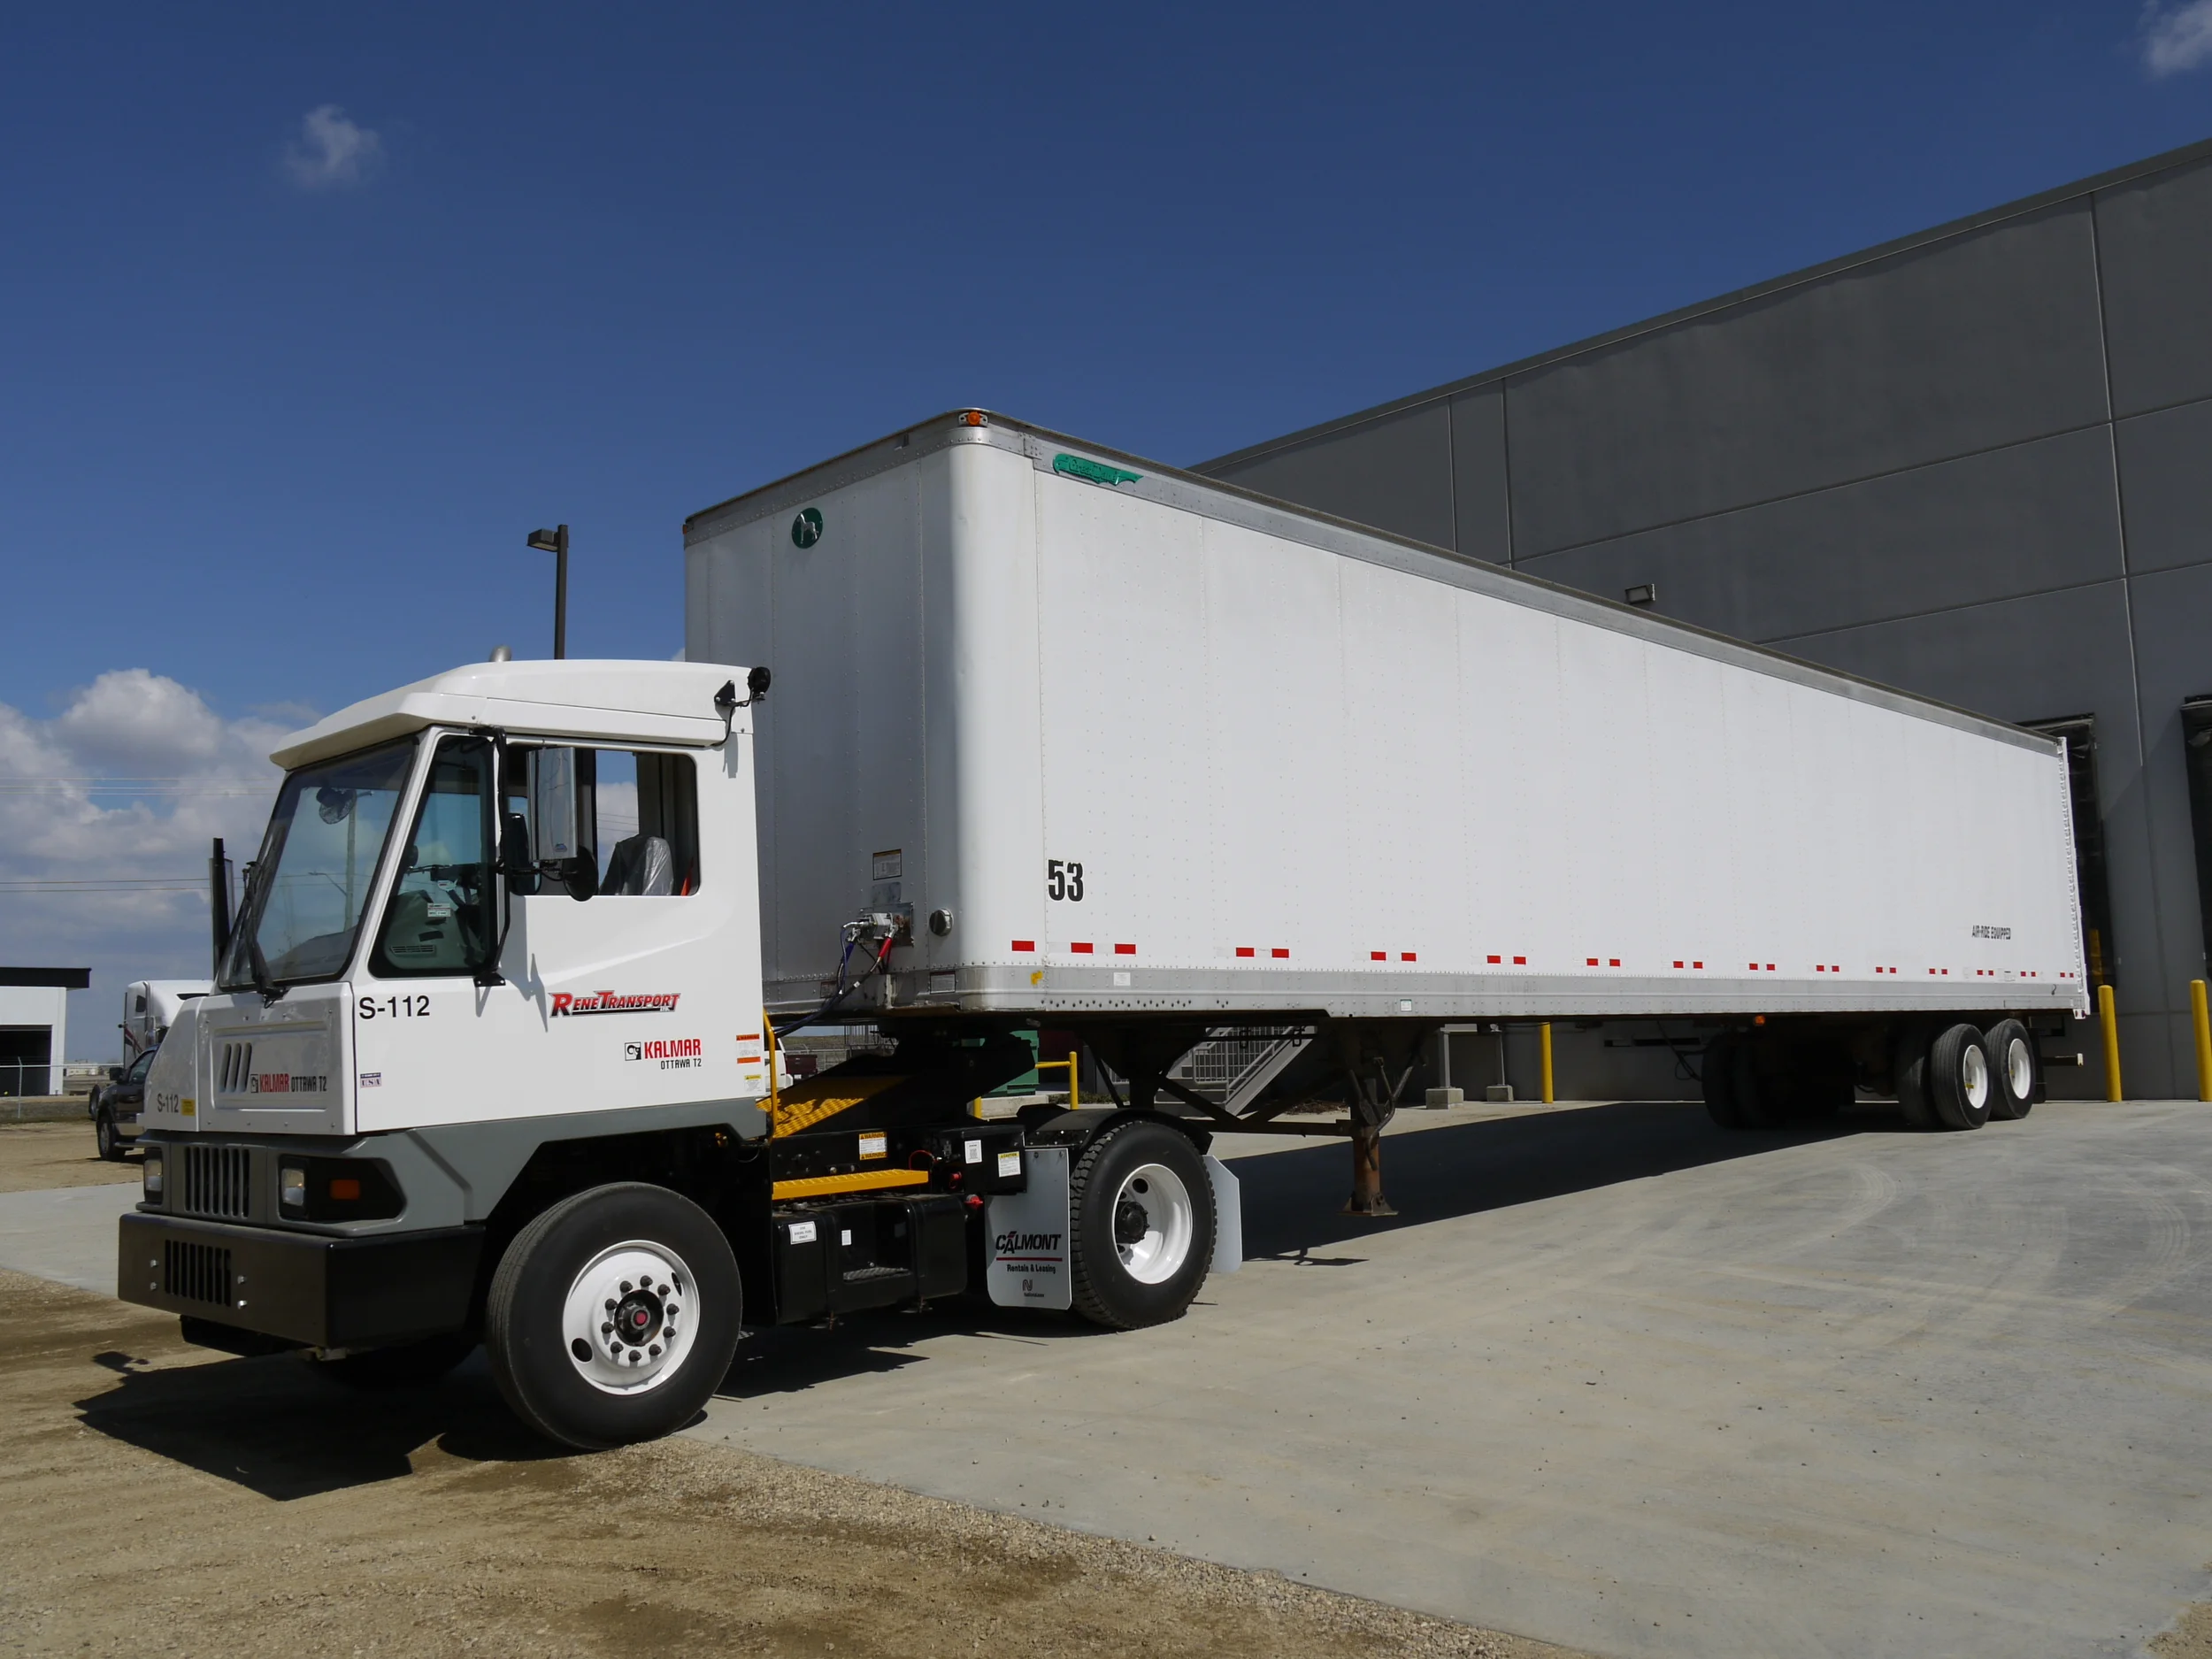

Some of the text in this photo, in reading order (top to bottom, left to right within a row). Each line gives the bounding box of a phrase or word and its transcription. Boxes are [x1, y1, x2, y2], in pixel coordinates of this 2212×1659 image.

[1048, 859, 1084, 902] 53
[358, 995, 430, 1019] S-112
[644, 1039, 701, 1059] KALMAR
[661, 1058, 702, 1070] OTTAWA T2
[259, 1073, 327, 1093] KALMAR OTTAWA T2
[157, 1094, 179, 1112] S-112
[995, 1231, 1062, 1254] CALMONT
[1035, 1264, 1056, 1274] Leasing
